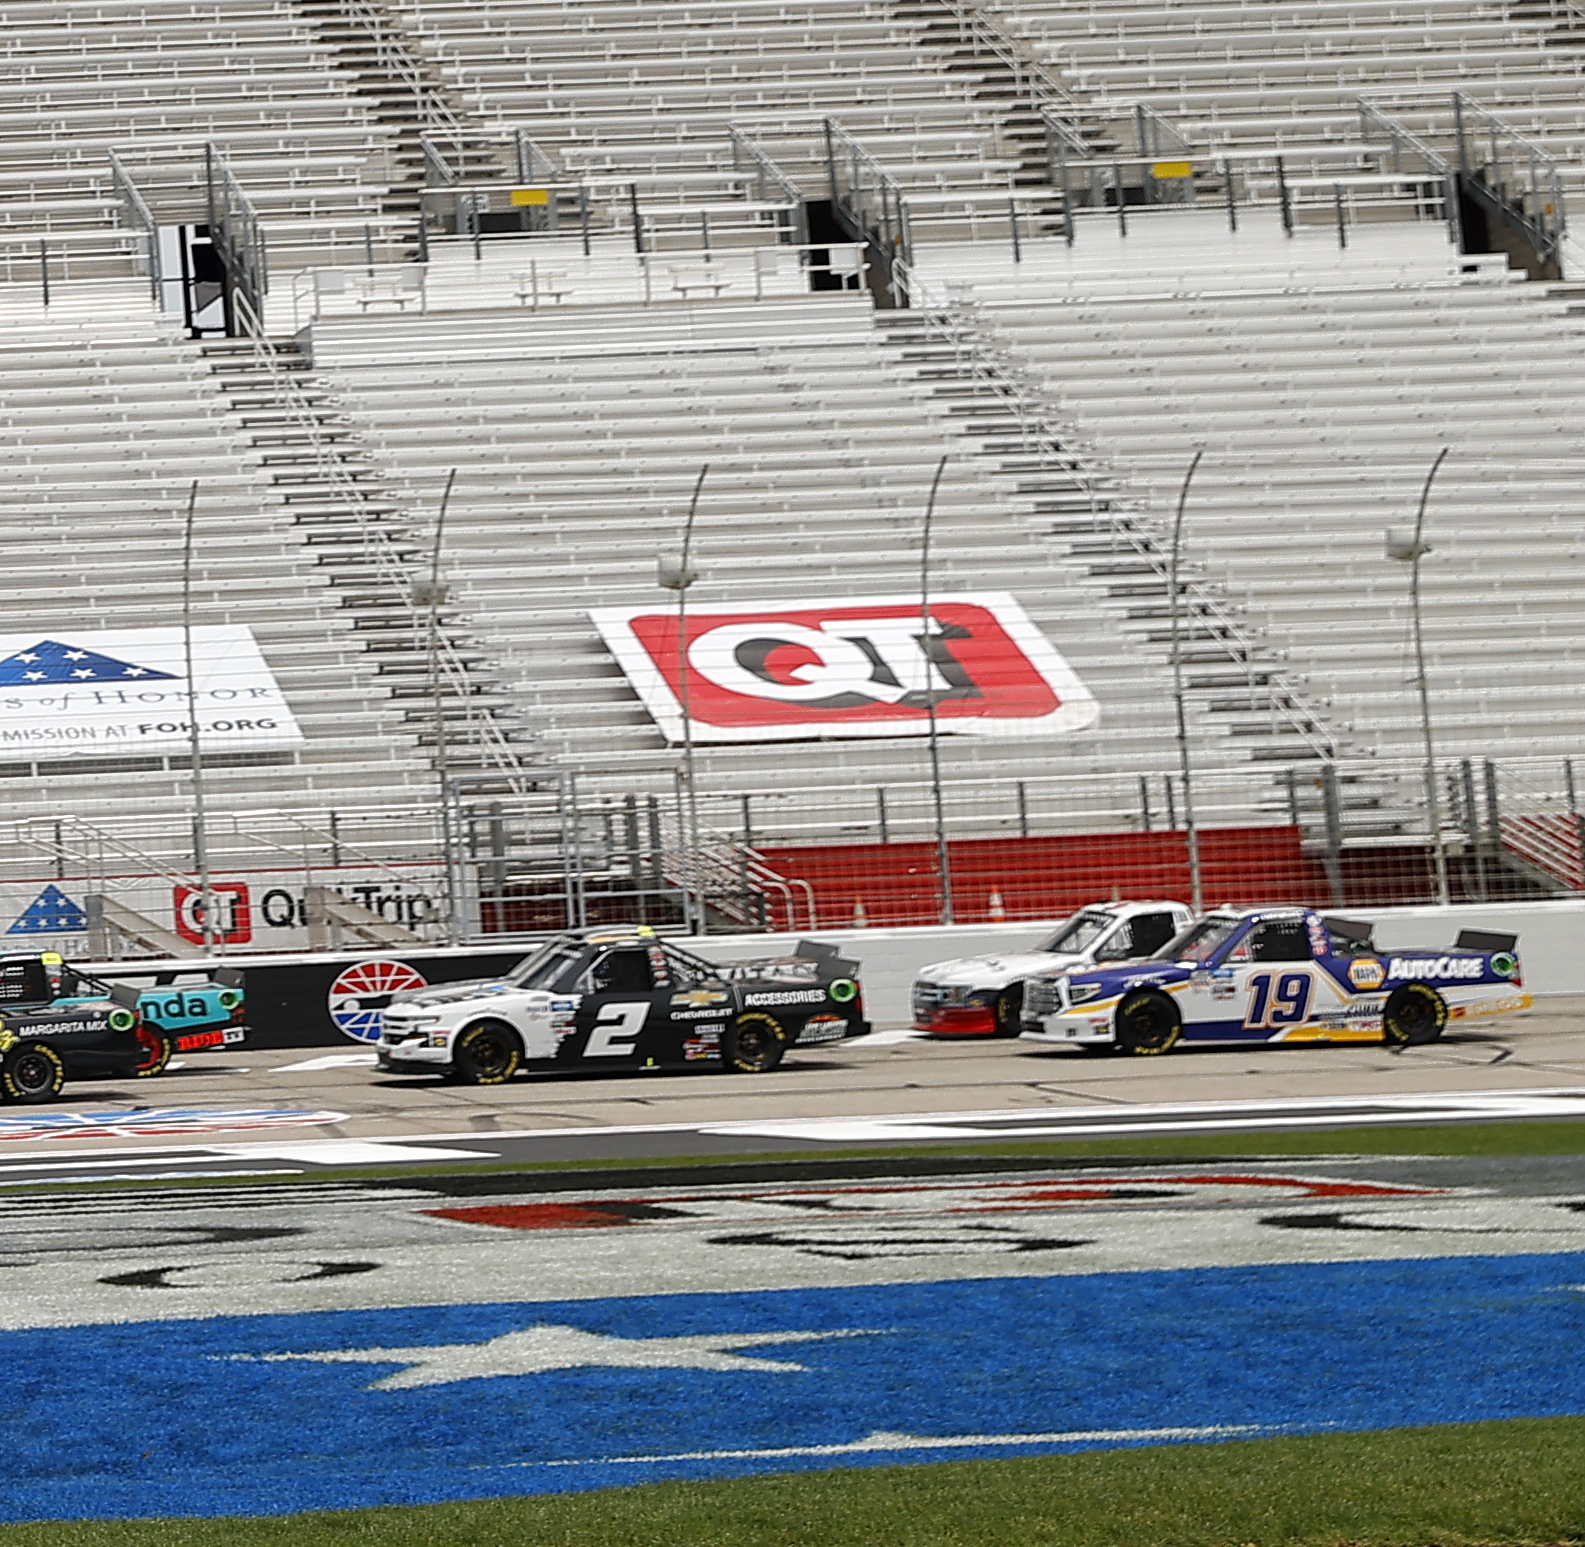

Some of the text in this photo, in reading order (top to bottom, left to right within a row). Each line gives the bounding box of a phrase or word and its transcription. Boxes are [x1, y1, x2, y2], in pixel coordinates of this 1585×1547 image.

[687, 617, 952, 705] QT
[39, 691, 77, 711] of
[3, 724, 97, 742] MISSION
[104, 723, 130, 738] AT
[181, 890, 240, 936] QT
[1242, 968, 1317, 1030] 19
[583, 1000, 651, 1057] 2
